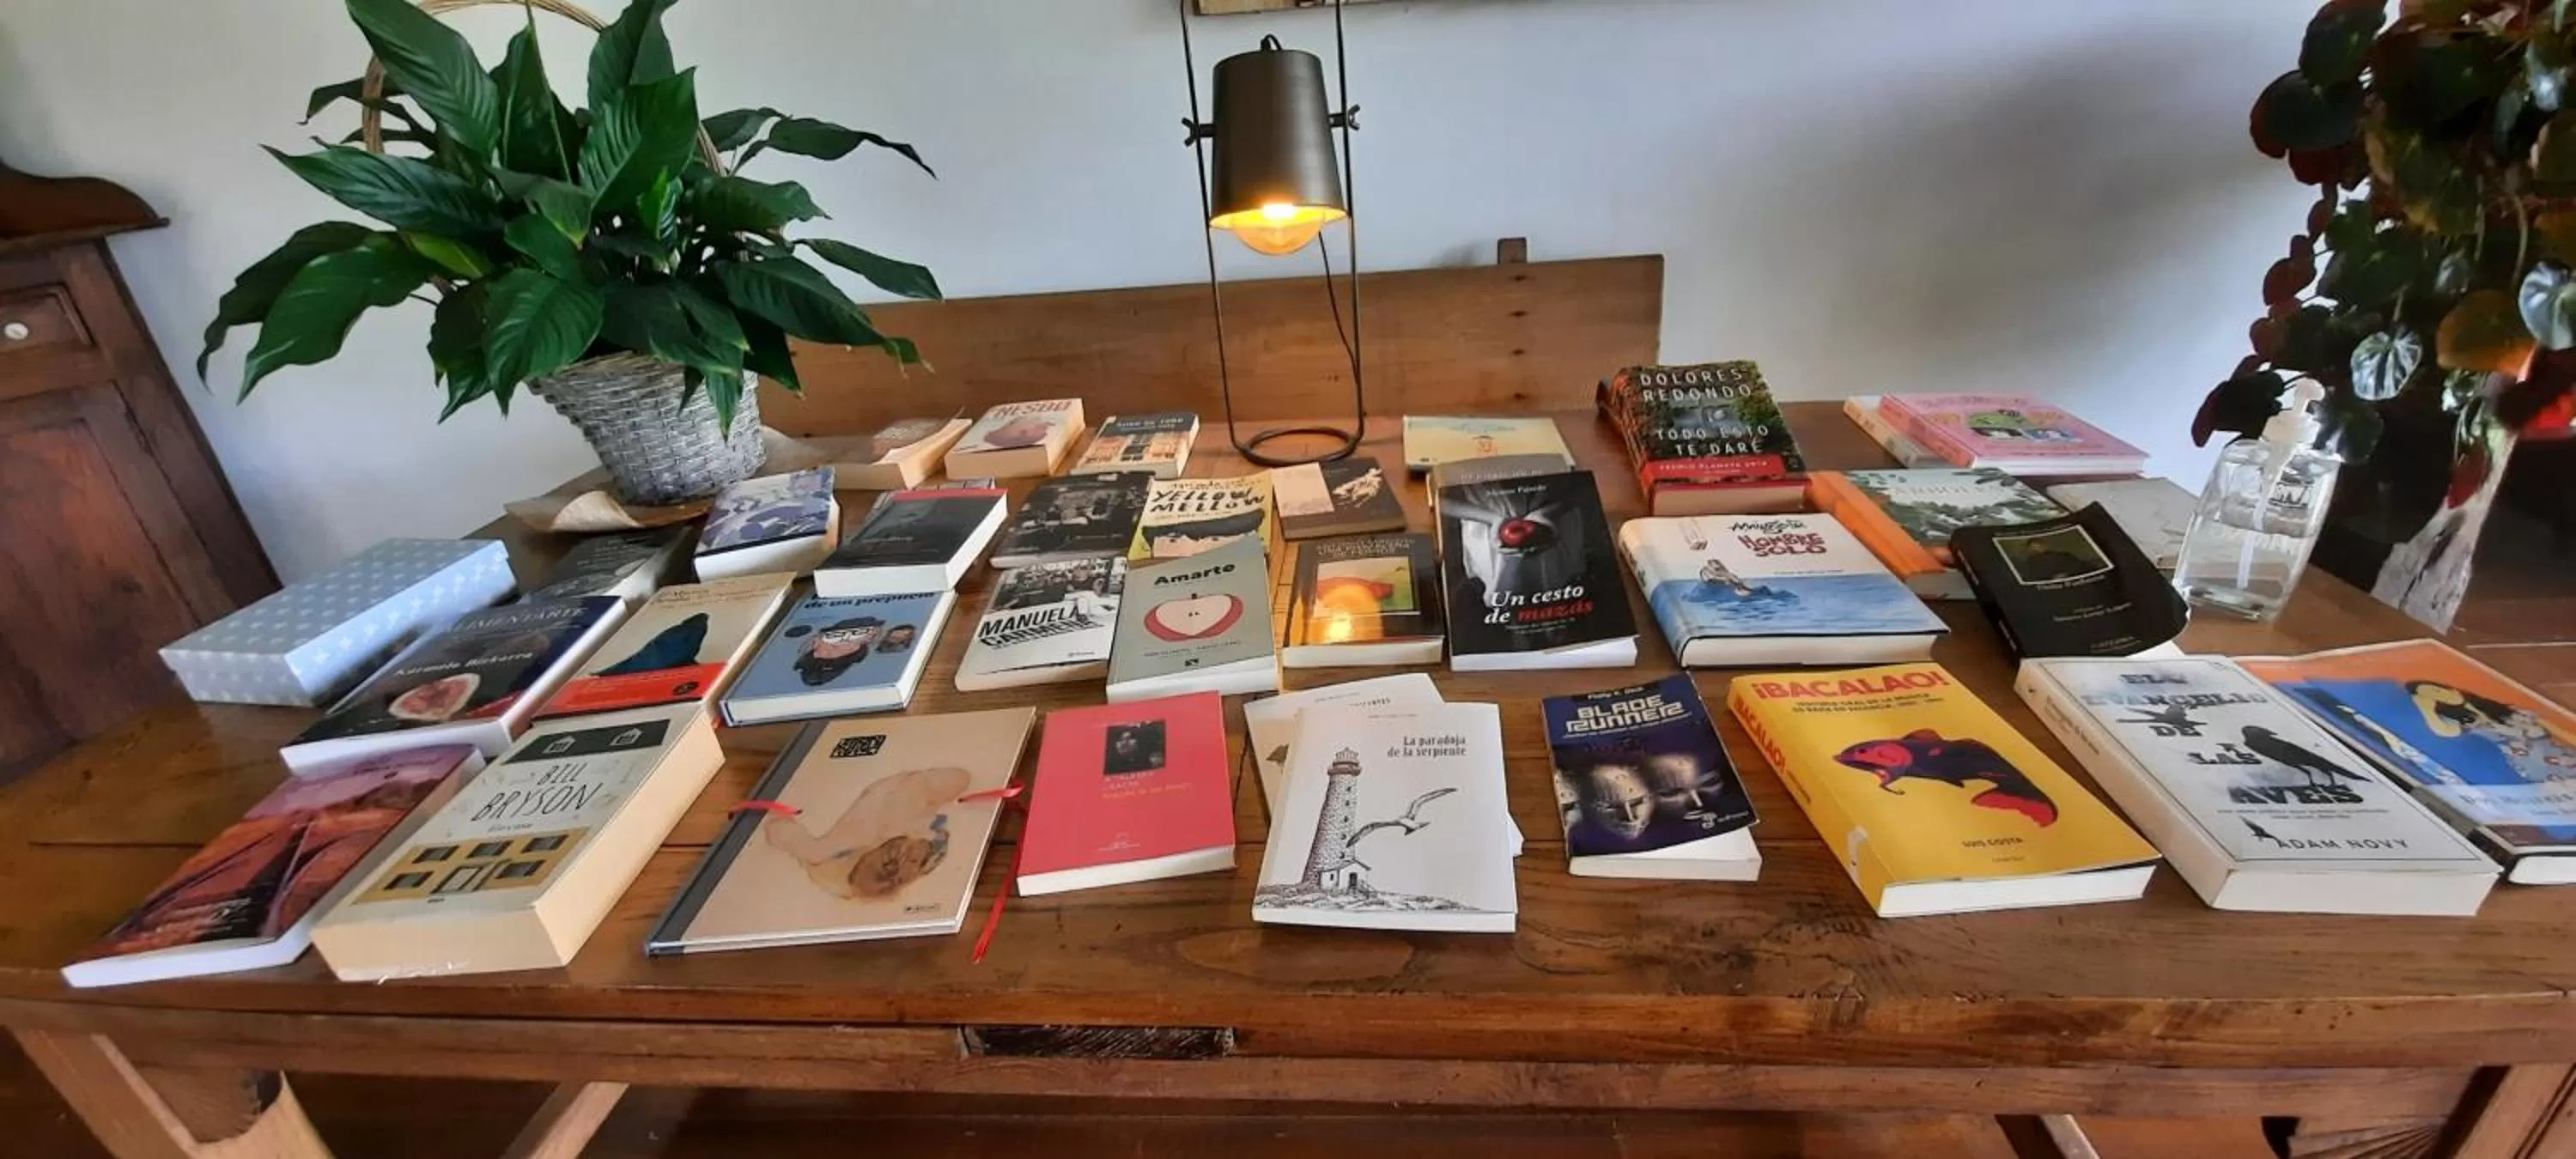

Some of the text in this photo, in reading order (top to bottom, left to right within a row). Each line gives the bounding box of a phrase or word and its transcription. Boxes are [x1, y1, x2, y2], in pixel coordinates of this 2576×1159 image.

[1640, 368, 1743, 386] DOLORES
[1643, 384, 1752, 402] REDONDO
[1656, 424, 1769, 440] TODO ESTO
[1675, 443, 1698, 456] TE
[1151, 495, 1265, 513] MELLOW
[1152, 487, 1253, 503] YELLOW
[1737, 532, 1826, 550] HOMBRE
[1753, 543, 1828, 557] SOLO
[1153, 563, 1236, 586] Amarte
[1491, 585, 1585, 607] Un cesto
[978, 603, 1082, 637] MANUELA
[1484, 607, 1511, 624] de
[1577, 693, 1665, 719] BLADE
[1565, 701, 1687, 733] RUNNER
[1403, 734, 1467, 748] La paradoja
[1387, 745, 1467, 758] de la serpiente
[2187, 752, 2263, 765] LAS
[537, 762, 587, 786] BILL
[471, 782, 604, 822] BRYSON
[2228, 783, 2364, 804] AVES
[1986, 836, 2024, 846] COSTA
[2276, 838, 2409, 850] ADAM NOVY
